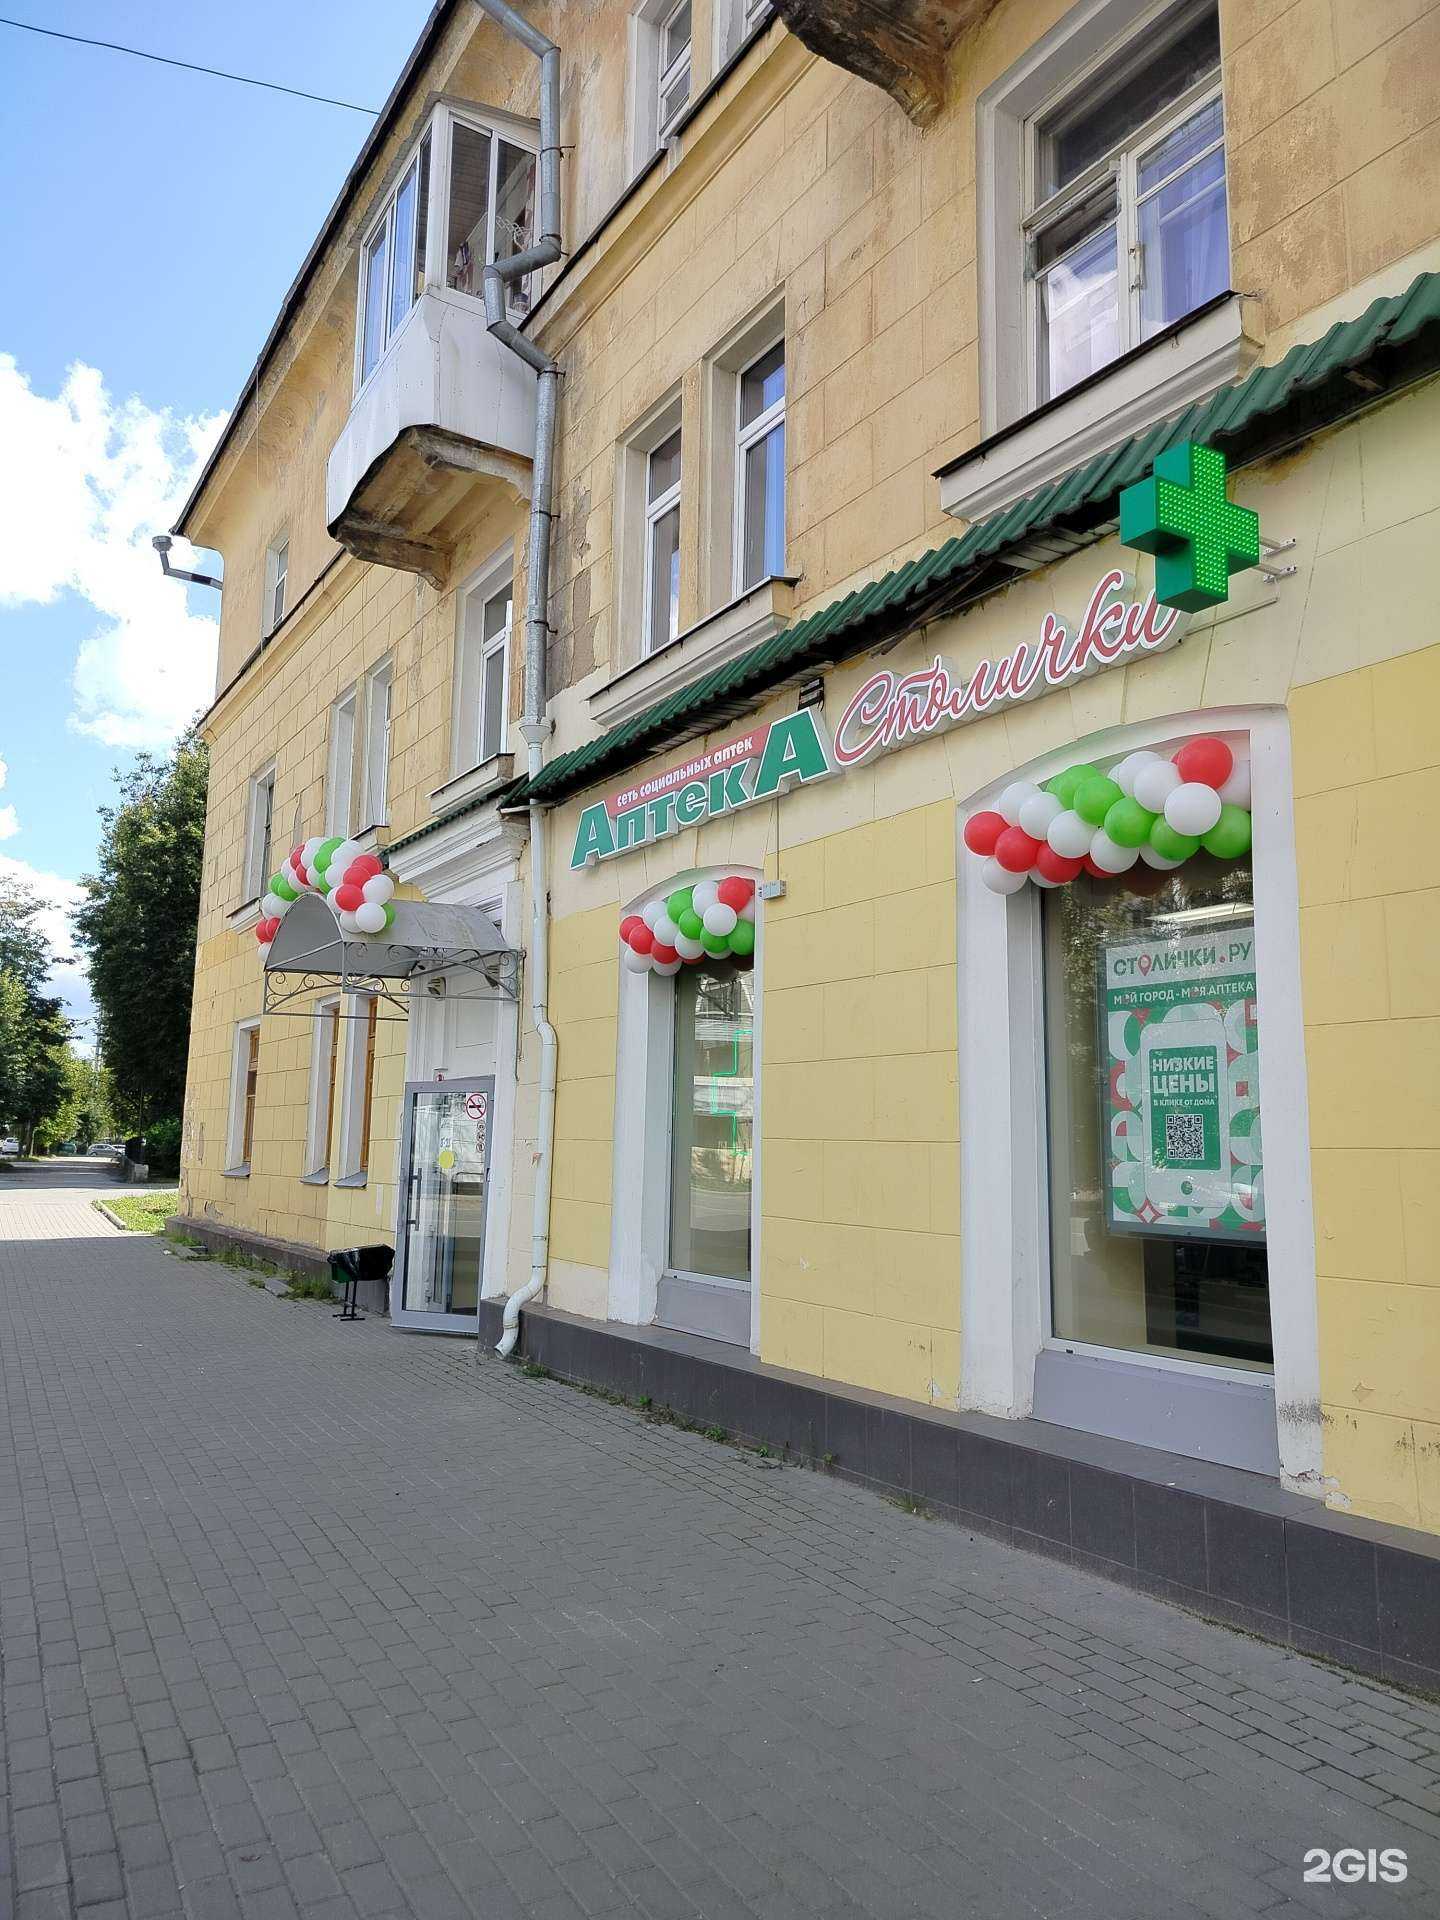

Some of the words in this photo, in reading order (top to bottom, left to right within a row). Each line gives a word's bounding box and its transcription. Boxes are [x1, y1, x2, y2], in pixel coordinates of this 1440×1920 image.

[834, 569, 1182, 765] Столички
[570, 707, 830, 870] АптекА
[616, 790, 638, 807] сеть
[639, 756, 712, 797] социальных
[713, 736, 753, 765] аптек
[1139, 989, 1174, 1002] ГОРОД
[1208, 981, 1254, 995] АПТЕКА
[1152, 1056, 1214, 1072] НИЗКИЕ
[1152, 1073, 1215, 1097] ЦЕНЫ
